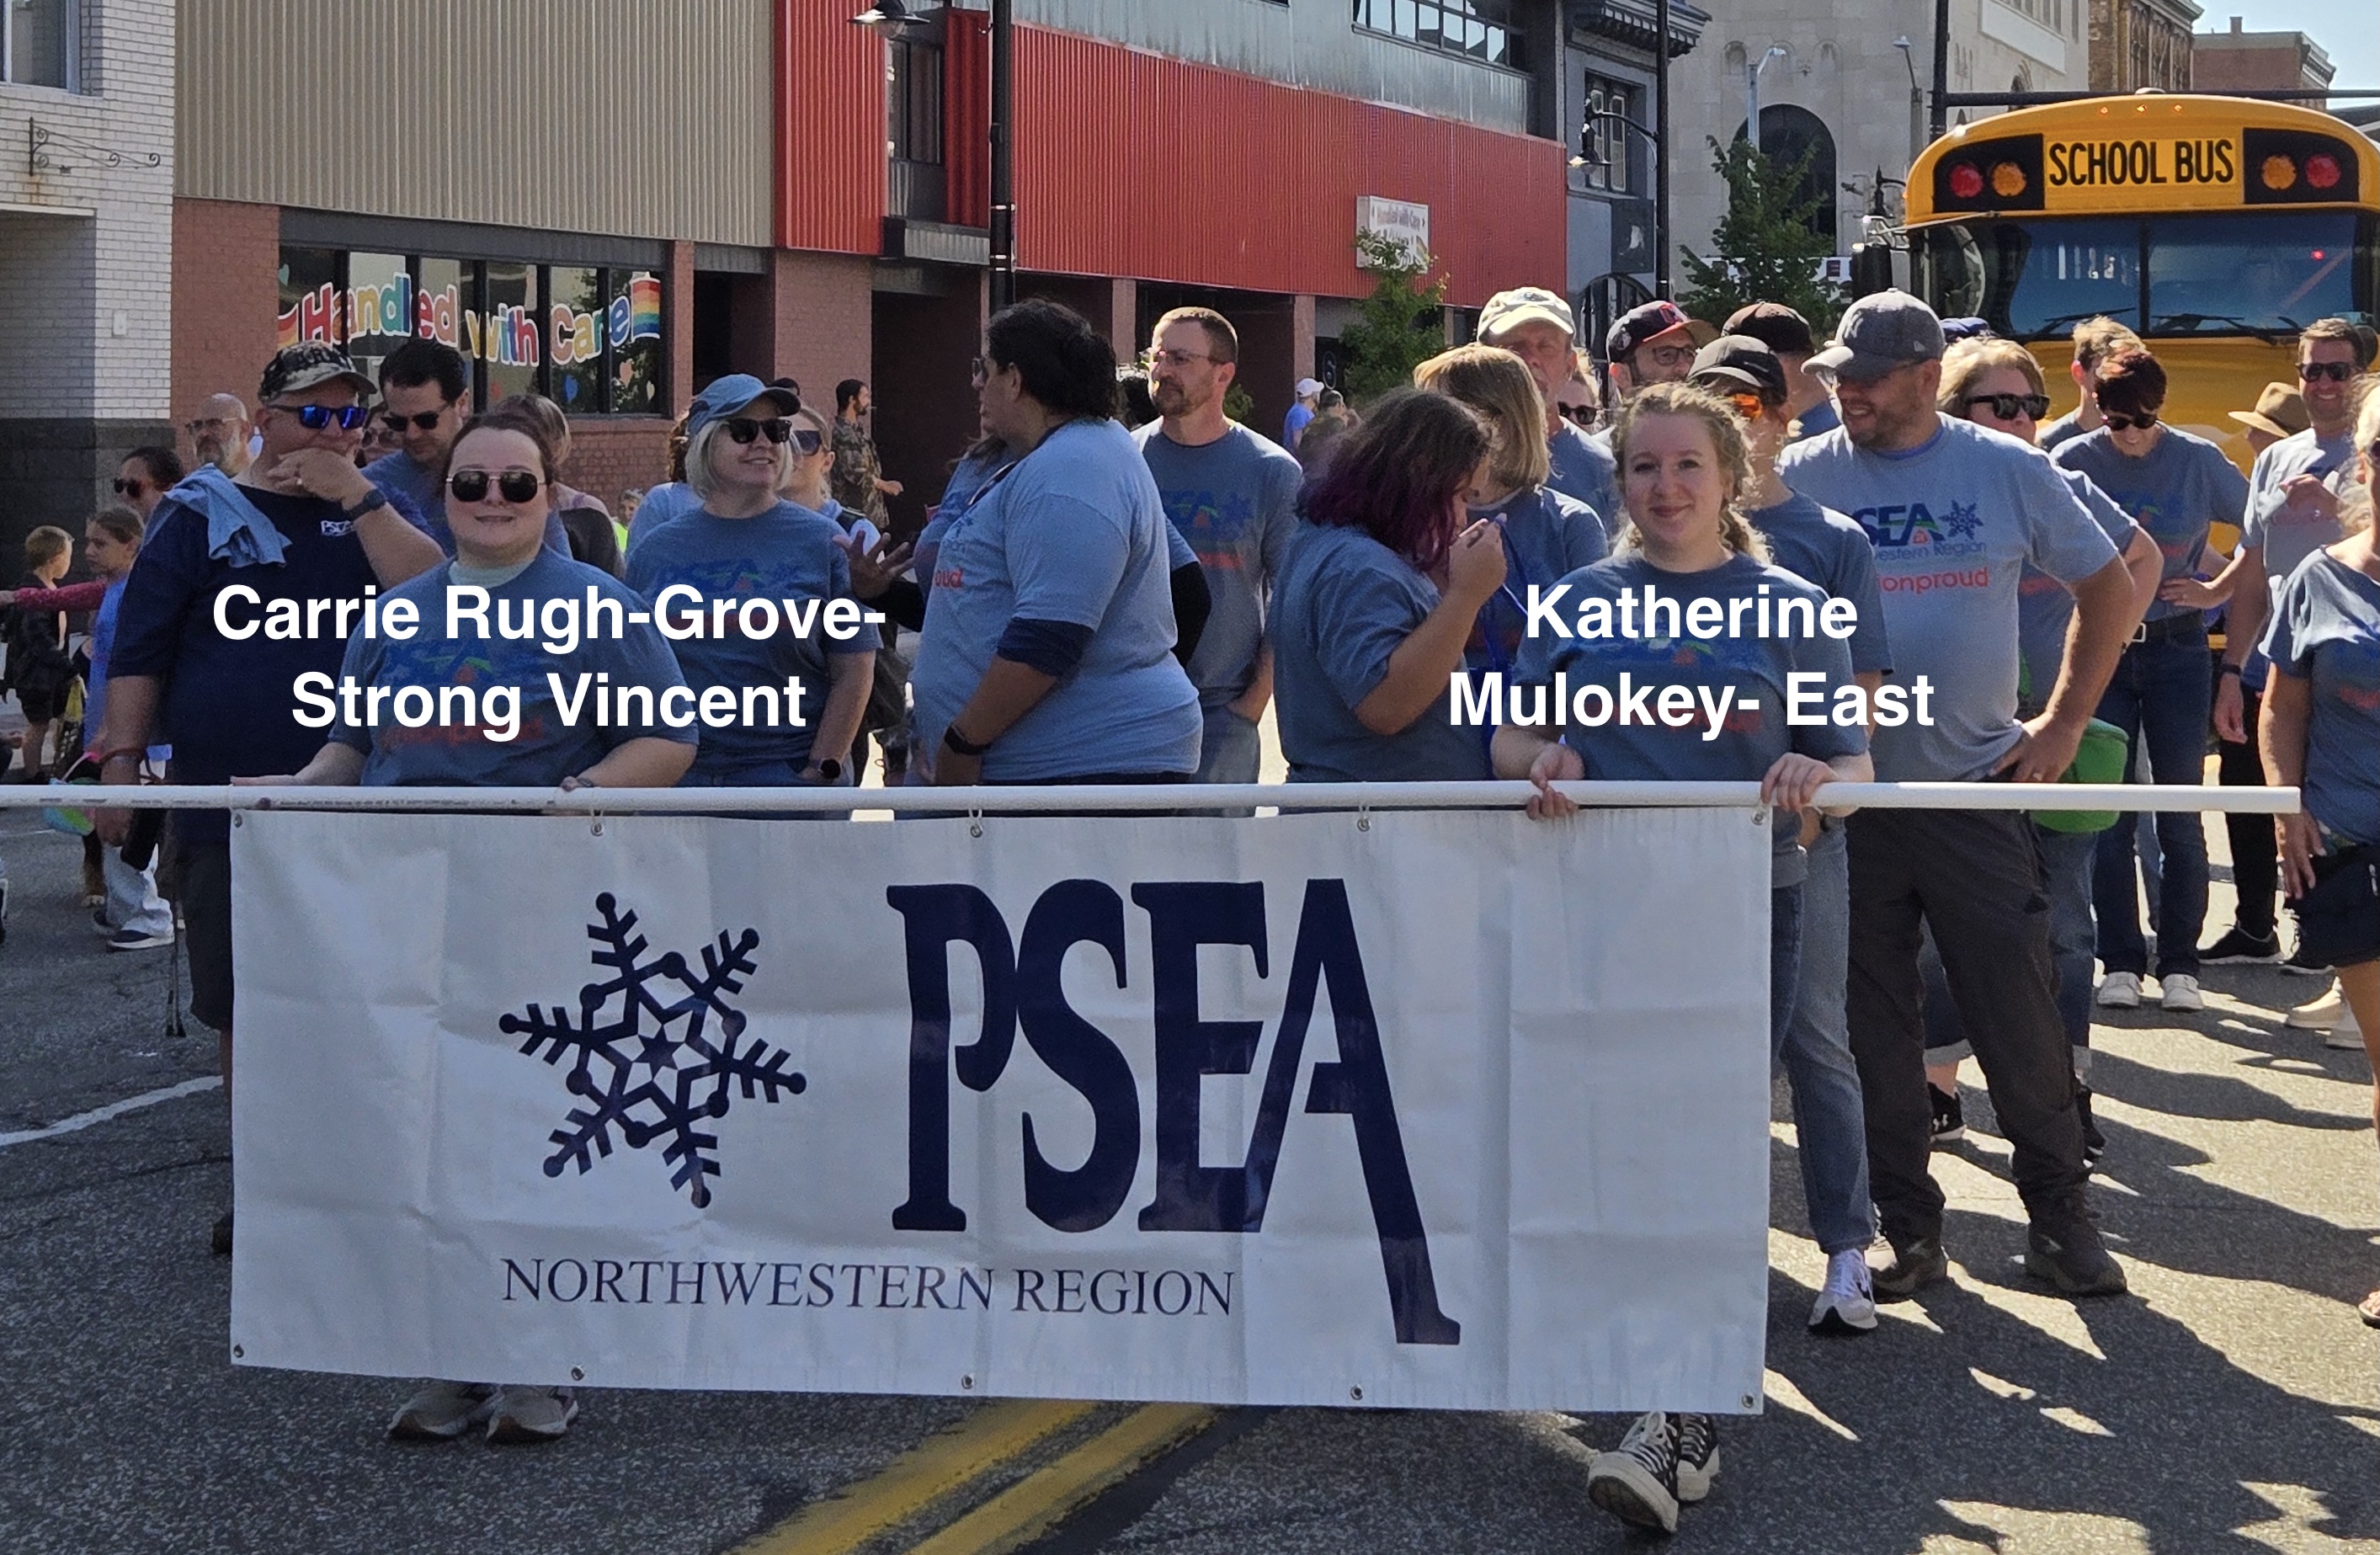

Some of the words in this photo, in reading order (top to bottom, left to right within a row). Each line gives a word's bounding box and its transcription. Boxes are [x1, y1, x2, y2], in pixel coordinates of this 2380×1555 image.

[2047, 140, 2167, 186] SCHOOL
[2175, 138, 2234, 184] BUS
[302, 272, 459, 348] Handled
[466, 302, 540, 367] with
[550, 295, 631, 365] Care
[1853, 503, 1946, 546] SEA
[1933, 541, 1987, 557] Region
[887, 879, 1460, 1345] PSEA
[501, 1258, 995, 1311] NORTHWESTERN
[1013, 1269, 1235, 1315] REGION
